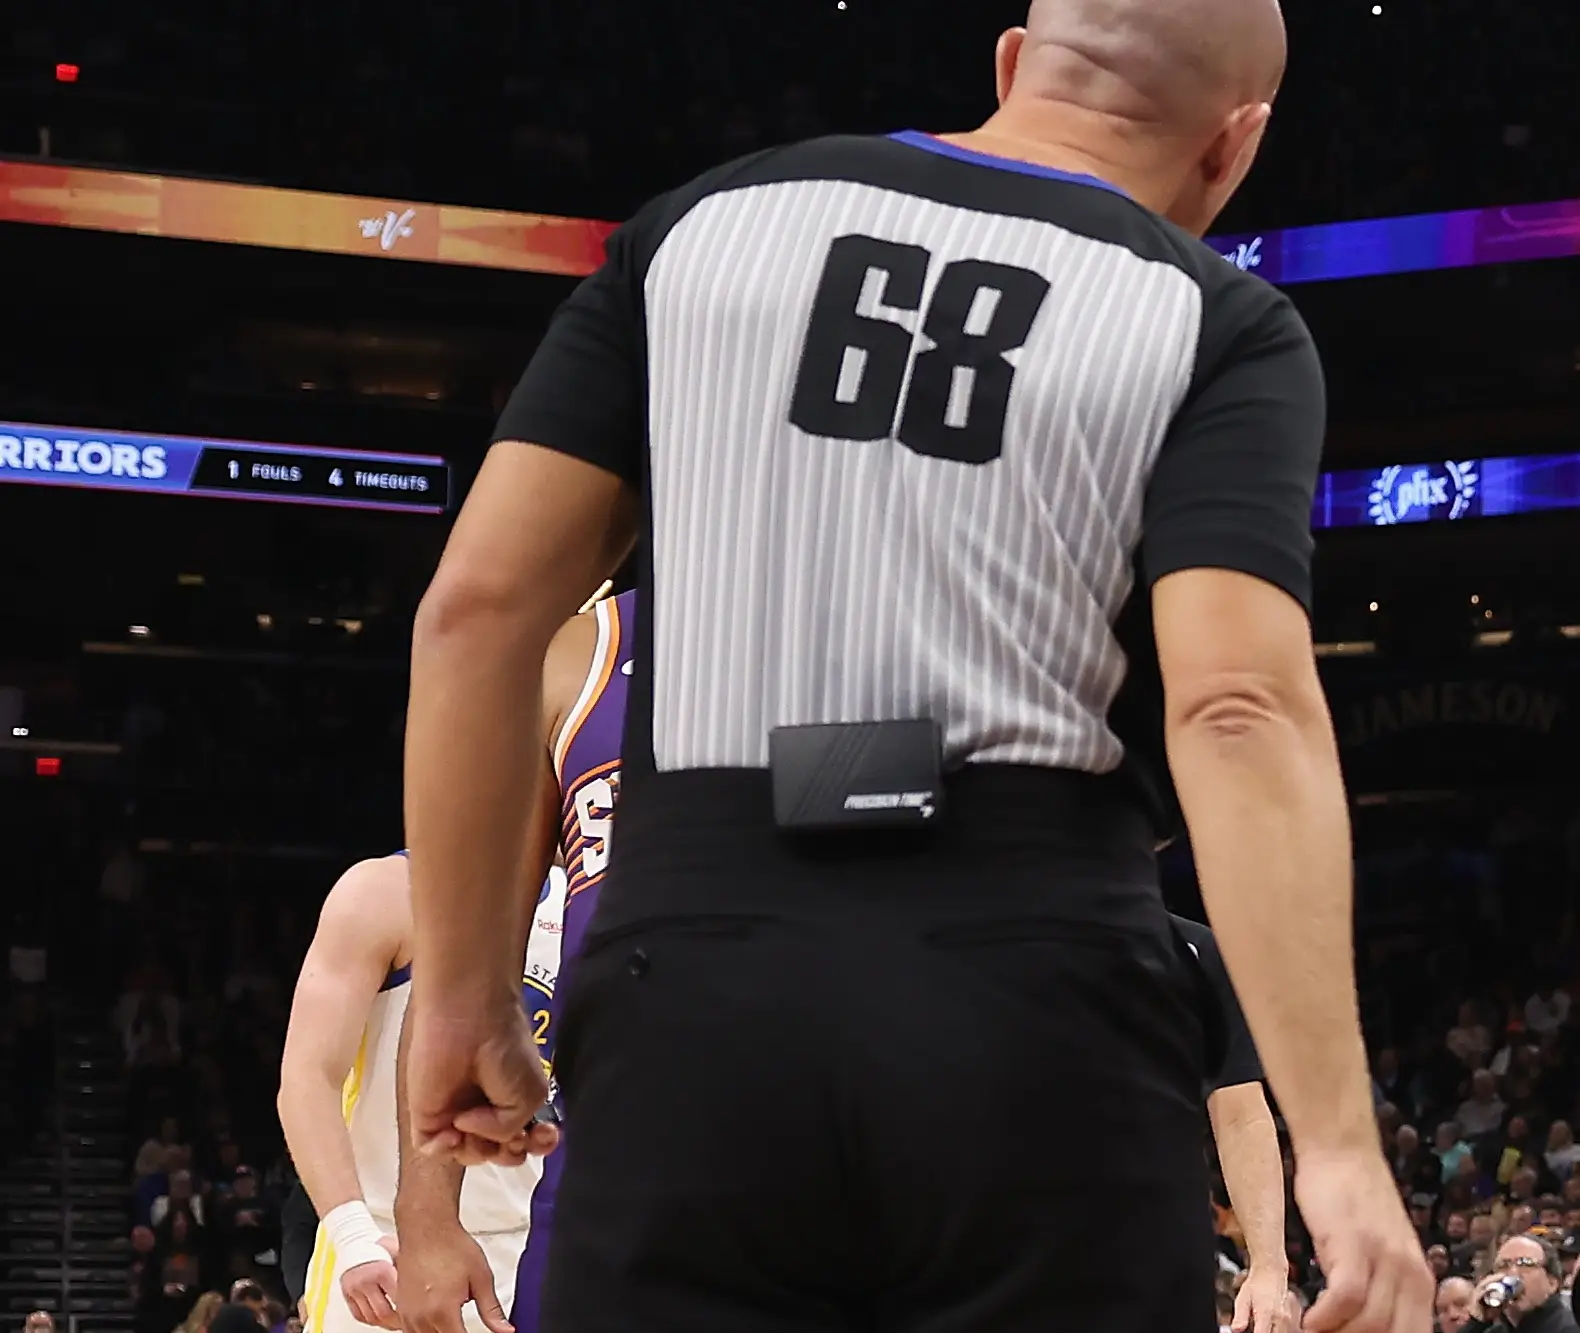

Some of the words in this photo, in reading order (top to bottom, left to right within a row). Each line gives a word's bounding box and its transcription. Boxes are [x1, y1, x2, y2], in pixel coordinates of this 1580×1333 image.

[789, 234, 1051, 465] 68
[0, 435, 167, 479] RRIORS
[227, 460, 239, 479] 1
[251, 463, 302, 482] FOULS
[328, 467, 344, 487] 4
[355, 471, 429, 492] TIMEOUTS
[1343, 678, 1560, 746] JAMESON
[575, 772, 618, 877] S
[533, 1009, 550, 1045] 2
